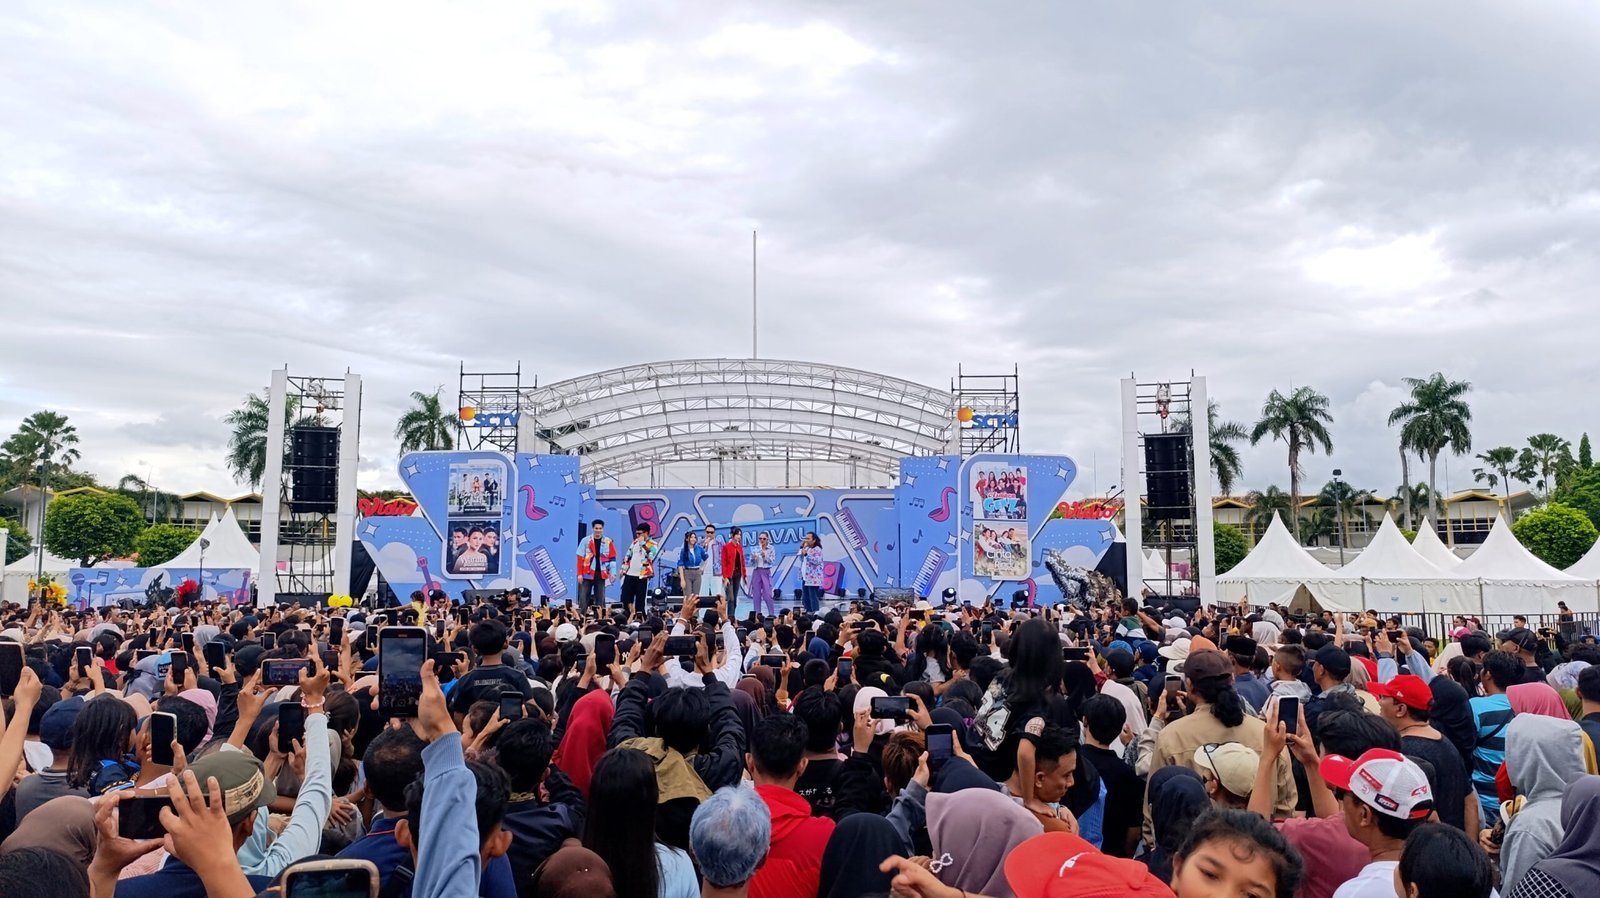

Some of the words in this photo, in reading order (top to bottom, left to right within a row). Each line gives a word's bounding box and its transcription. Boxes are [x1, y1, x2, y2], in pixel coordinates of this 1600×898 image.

[474, 413, 521, 428] SCTV
[972, 414, 1018, 429] SCTV
[1057, 501, 1118, 519] Vidio
